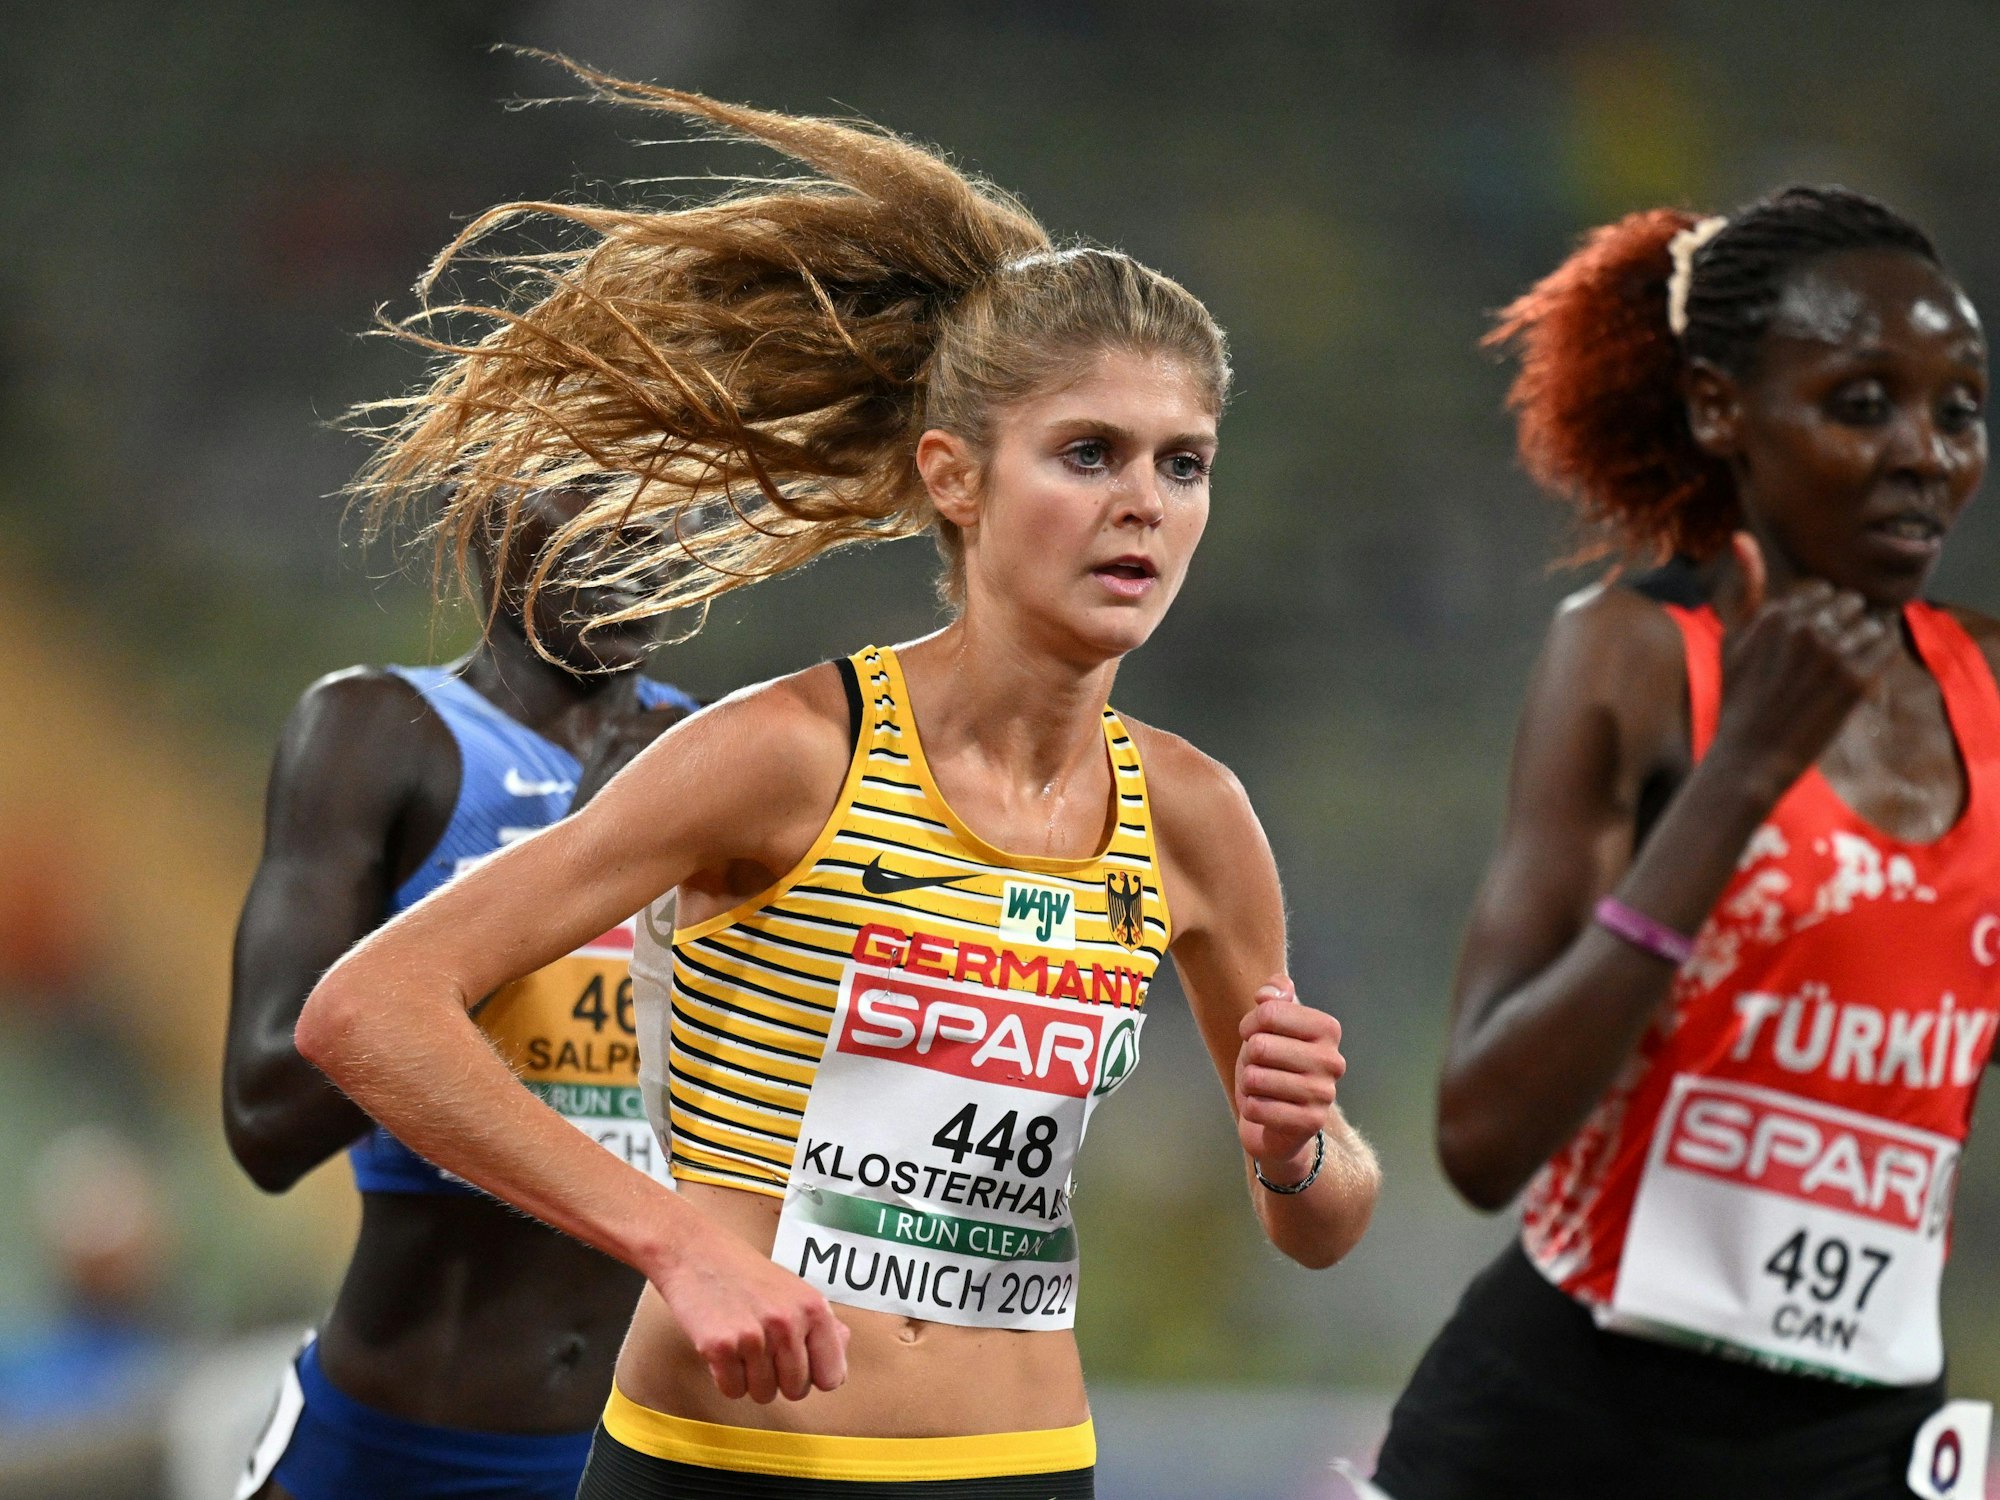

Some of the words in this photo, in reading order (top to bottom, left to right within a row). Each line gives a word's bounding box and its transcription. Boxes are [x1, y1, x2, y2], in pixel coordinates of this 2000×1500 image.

[852, 923, 1143, 1011] GERMANY
[851, 988, 1094, 1086] SPAR
[1732, 982, 1997, 1090] TÜRKİY
[932, 1103, 1058, 1178] 448
[1676, 1099, 1929, 1219] SPAR
[878, 1208, 887, 1234] I
[896, 1212, 959, 1247] RUN
[968, 1226, 1045, 1258] CLEAN
[1765, 1229, 1893, 1312] 497
[799, 1237, 992, 1312] MUNICH
[997, 1272, 1073, 1316] 2022
[1772, 1305, 1859, 1352] CAN
